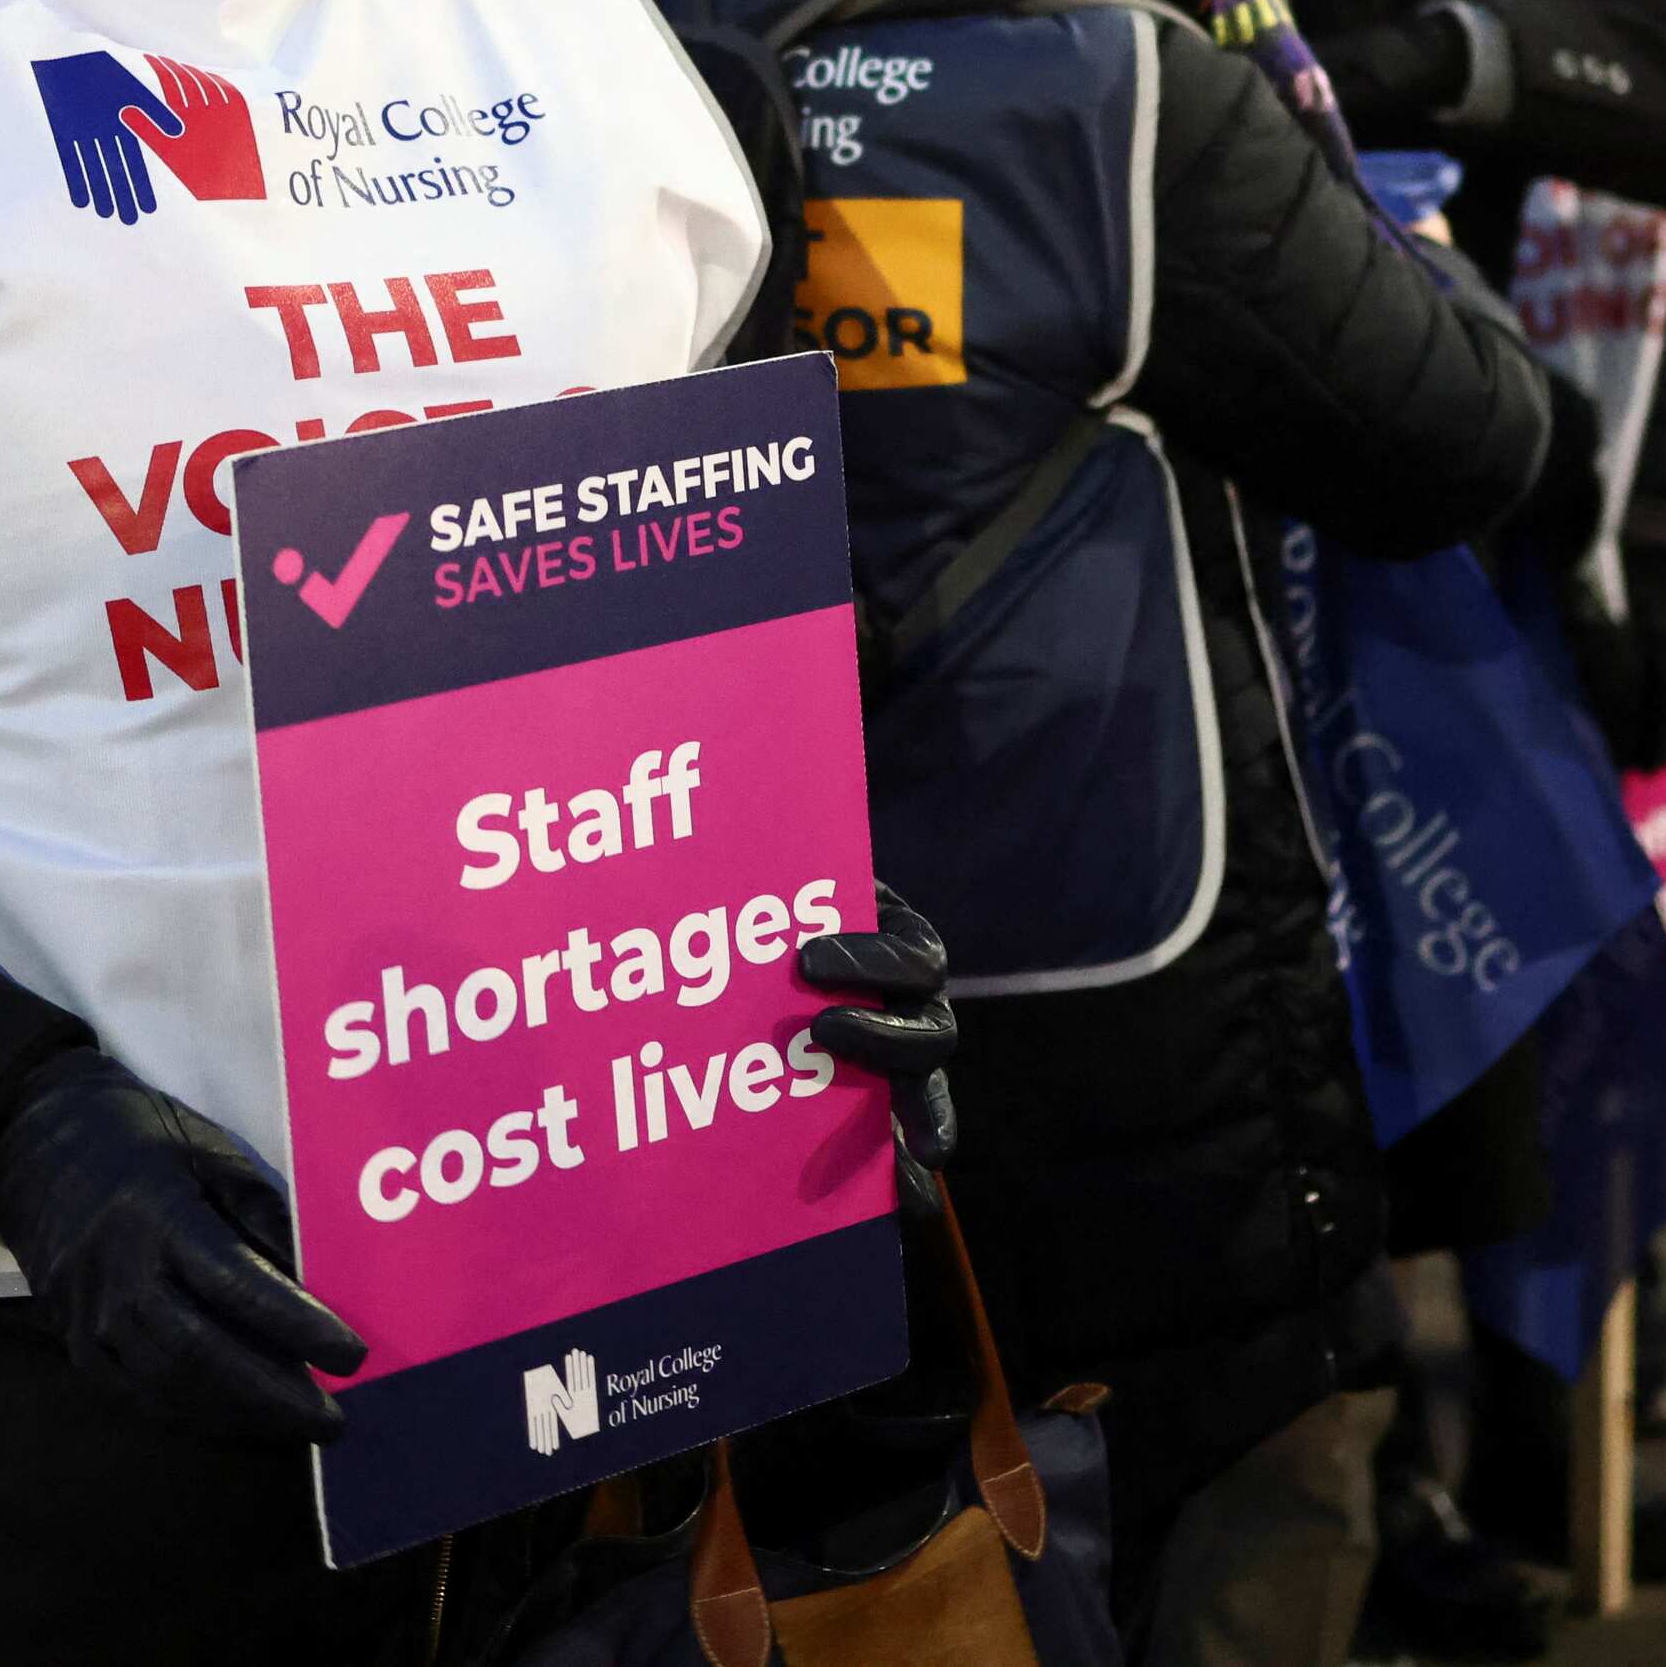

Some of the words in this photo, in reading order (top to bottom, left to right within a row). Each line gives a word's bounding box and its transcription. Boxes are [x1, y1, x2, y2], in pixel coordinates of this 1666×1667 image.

[275, 90, 376, 161] Royal
[381, 92, 546, 146] College
[289, 159, 324, 207] of
[333, 156, 515, 208] Nursing
[244, 268, 521, 380] THE
[430, 483, 567, 552] SAFE
[577, 436, 816, 523] STAFFING
[434, 535, 596, 608] SAVES
[612, 505, 744, 572] LIVES
[455, 741, 701, 890] Staff
[1336, 731, 1520, 993] College
[323, 878, 842, 1080] shortages
[358, 1084, 585, 1223] cost
[611, 1026, 835, 1152] lives
[606, 1359, 655, 1397] Royal
[658, 1343, 722, 1376] College
[608, 1399, 629, 1428] of
[632, 1383, 700, 1421] Nursing
